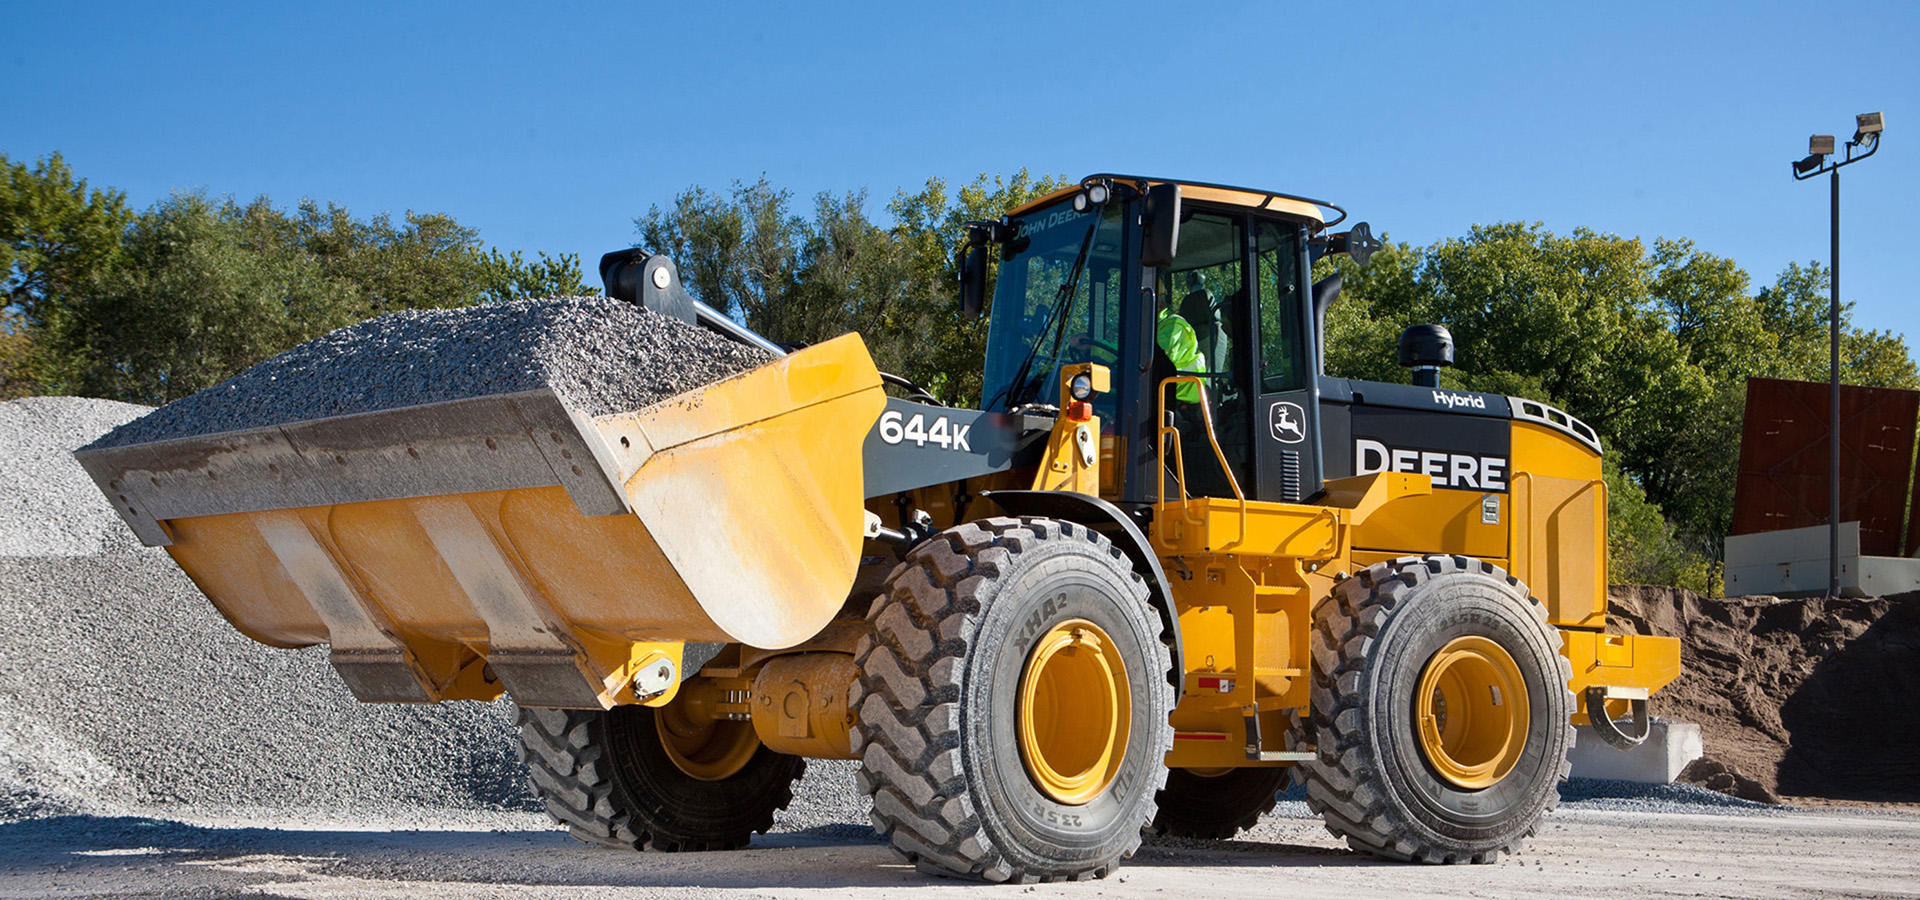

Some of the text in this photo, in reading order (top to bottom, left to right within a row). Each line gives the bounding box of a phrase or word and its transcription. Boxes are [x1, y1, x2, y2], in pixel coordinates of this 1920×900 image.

[1013, 218, 1047, 241] JOHN
[1432, 390, 1486, 409] Hybrid
[879, 410, 971, 452] 644K
[1355, 438, 1506, 490] DEERE
[1013, 592, 1067, 658] XHA2
